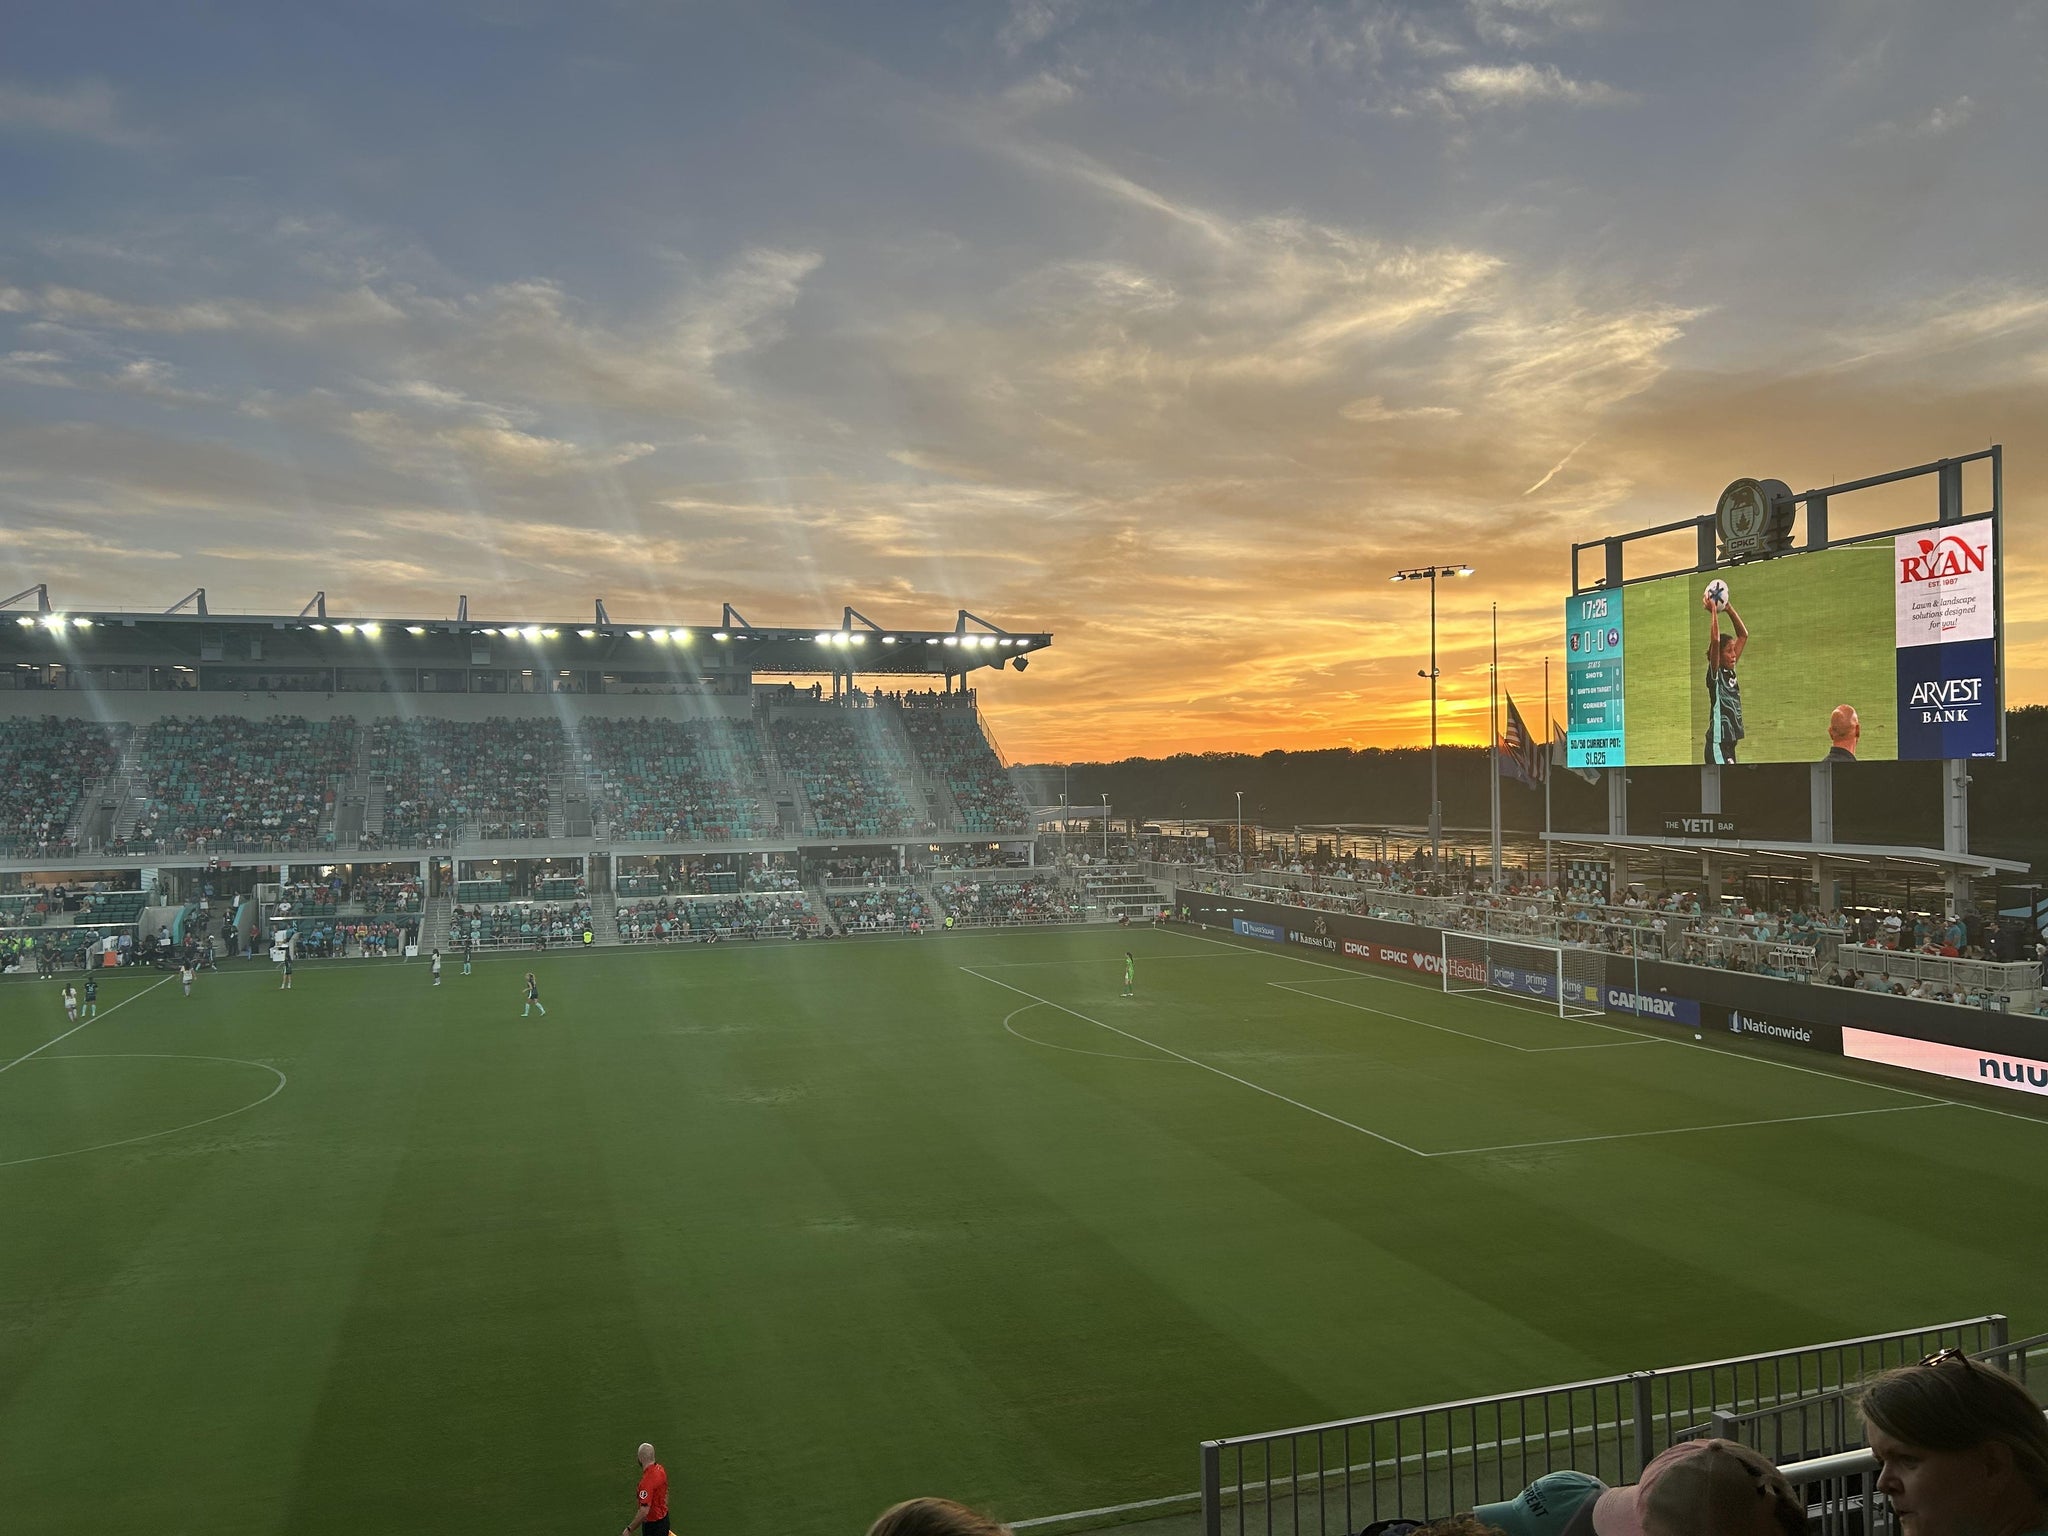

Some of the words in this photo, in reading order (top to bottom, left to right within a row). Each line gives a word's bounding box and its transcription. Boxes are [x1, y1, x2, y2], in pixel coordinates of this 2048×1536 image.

[1731, 538, 1755, 550] CPKC
[1900, 536, 1988, 584] RYAN
[1928, 580, 1940, 588] EST.
[1942, 578, 1958, 586] 1987
[1582, 598, 1607, 620] 17:25
[1912, 602, 1932, 610] Lawn
[1940, 595, 1976, 606] landscape
[1912, 610, 1943, 620] solutions
[1944, 605, 1976, 617] designed
[1928, 620, 1940, 630] for
[1942, 618, 1958, 628] you!
[1585, 671, 1603, 679] SHOTS
[1910, 678, 1982, 709] ARVEST
[1582, 701, 1607, 709] CORNERS
[1586, 716, 1603, 724] SAVES
[1922, 709, 1969, 723] BANK
[1570, 739, 1586, 750] 50/50
[1586, 738, 1609, 749] CURRENT
[1665, 821, 1679, 829] THE
[1681, 818, 1714, 833] YETI
[1717, 822, 1734, 831] BAR
[1300, 932, 1323, 947] Kansas
[1323, 936, 1337, 952] City
[1344, 941, 1370, 957] CPKC
[1380, 949, 1408, 964] CPKC
[1448, 959, 1487, 982] Health
[1494, 968, 1515, 981] prime
[1525, 973, 1547, 986] prime
[1561, 978, 1581, 993] rime
[1743, 1016, 1811, 1042] Nationwide
[1979, 1058, 2048, 1087] nuu
